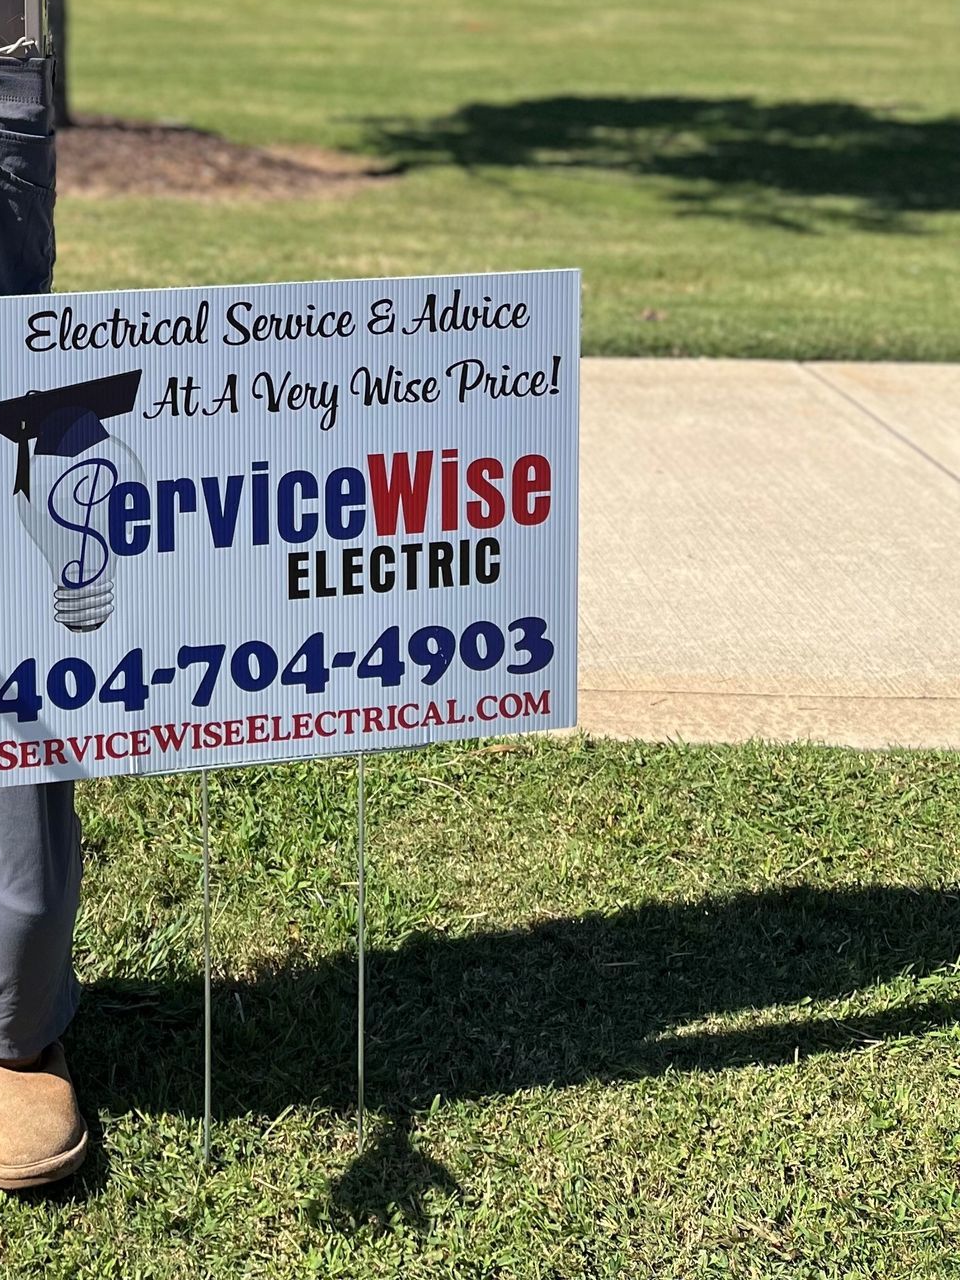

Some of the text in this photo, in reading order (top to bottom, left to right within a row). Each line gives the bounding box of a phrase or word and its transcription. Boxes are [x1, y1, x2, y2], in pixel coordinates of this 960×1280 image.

[25, 289, 531, 352] Electrical Service & Advice
[142, 355, 560, 431] At A Very Wise Price!
[47, 448, 553, 589] ServiceWise
[287, 537, 501, 601] ELECTRIC
